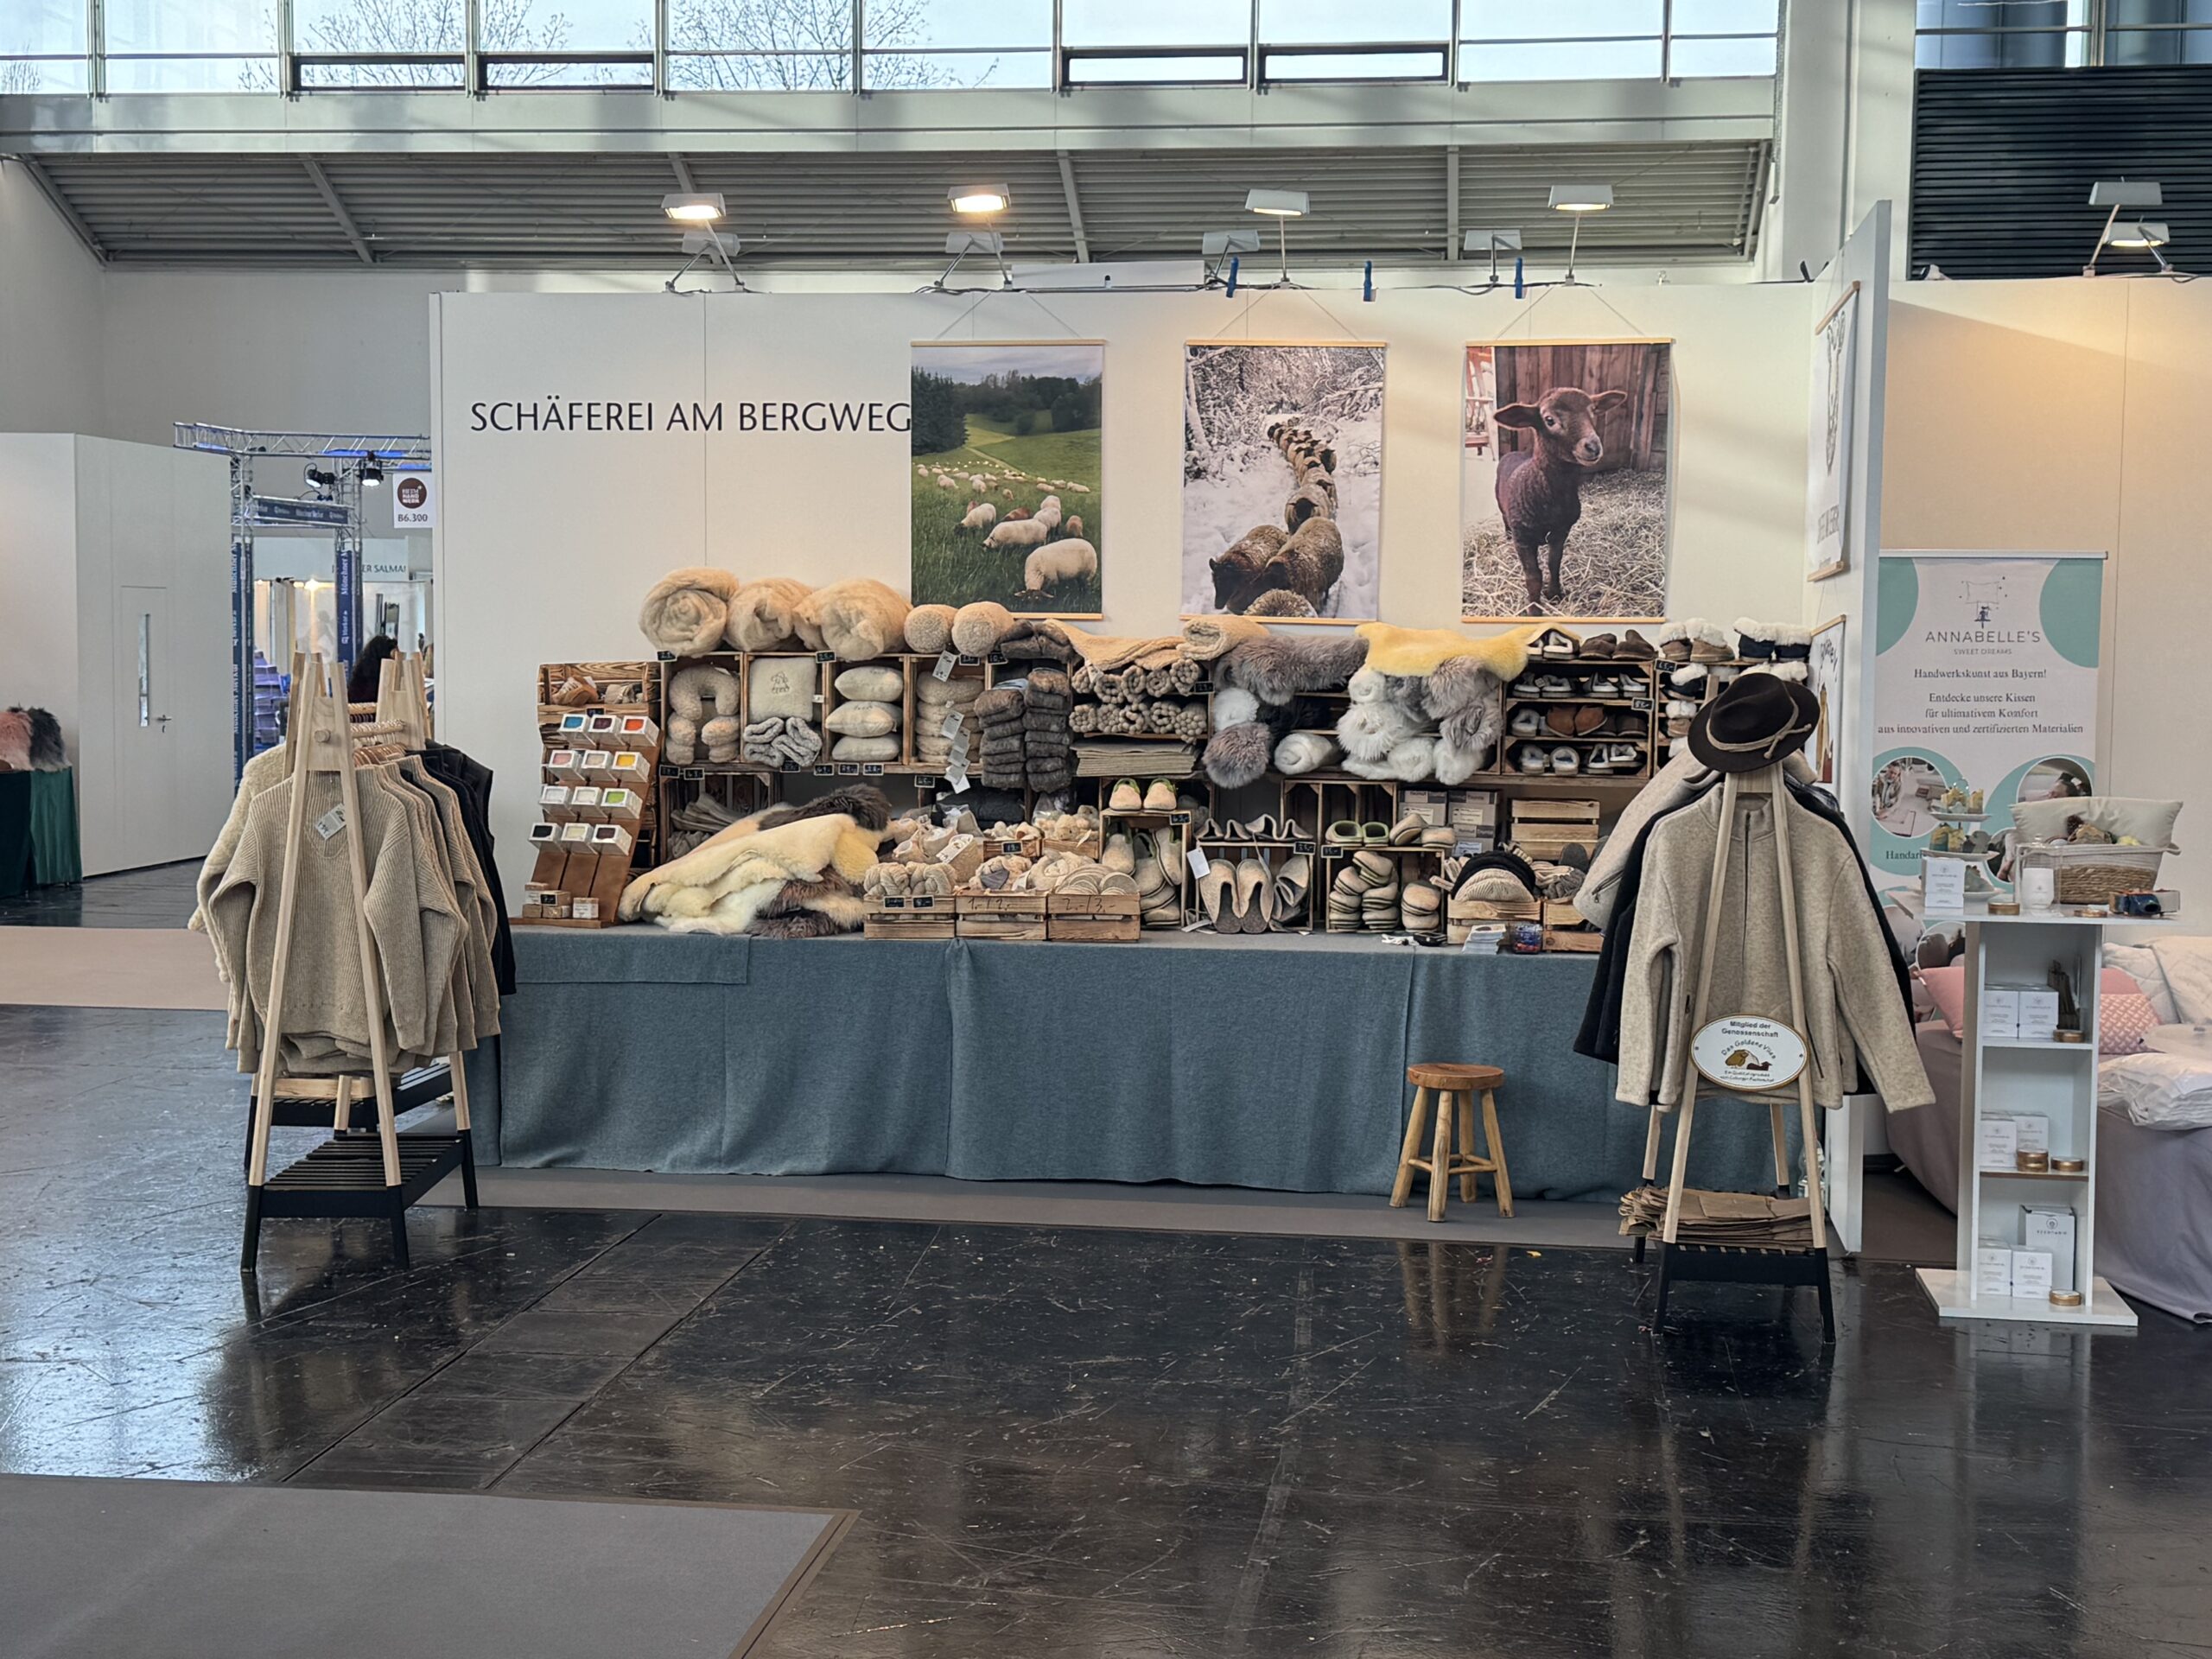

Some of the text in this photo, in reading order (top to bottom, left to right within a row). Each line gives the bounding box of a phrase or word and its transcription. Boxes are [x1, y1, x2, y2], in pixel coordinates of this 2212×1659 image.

[470, 395, 912, 432] SCHÄFEREI AM BERGWEG
[397, 513, 428, 522] B6.300
[1925, 631, 2041, 643] ANNABELLE'S
[1914, 669, 1991, 678] Handwerkskunst
[2012, 669, 2047, 680] Bayern!
[1929, 693, 1972, 702] Entdecke
[2005, 693, 2036, 702] Kissen
[1925, 708, 2038, 718] für ultimativem Komfort
[1897, 724, 1950, 734] innovativen
[1953, 724, 1970, 734] und
[1973, 724, 2030, 734] zertifizierten
[2032, 724, 2084, 734] Materialien
[1721, 1027, 1778, 1038] Genossenschaft
